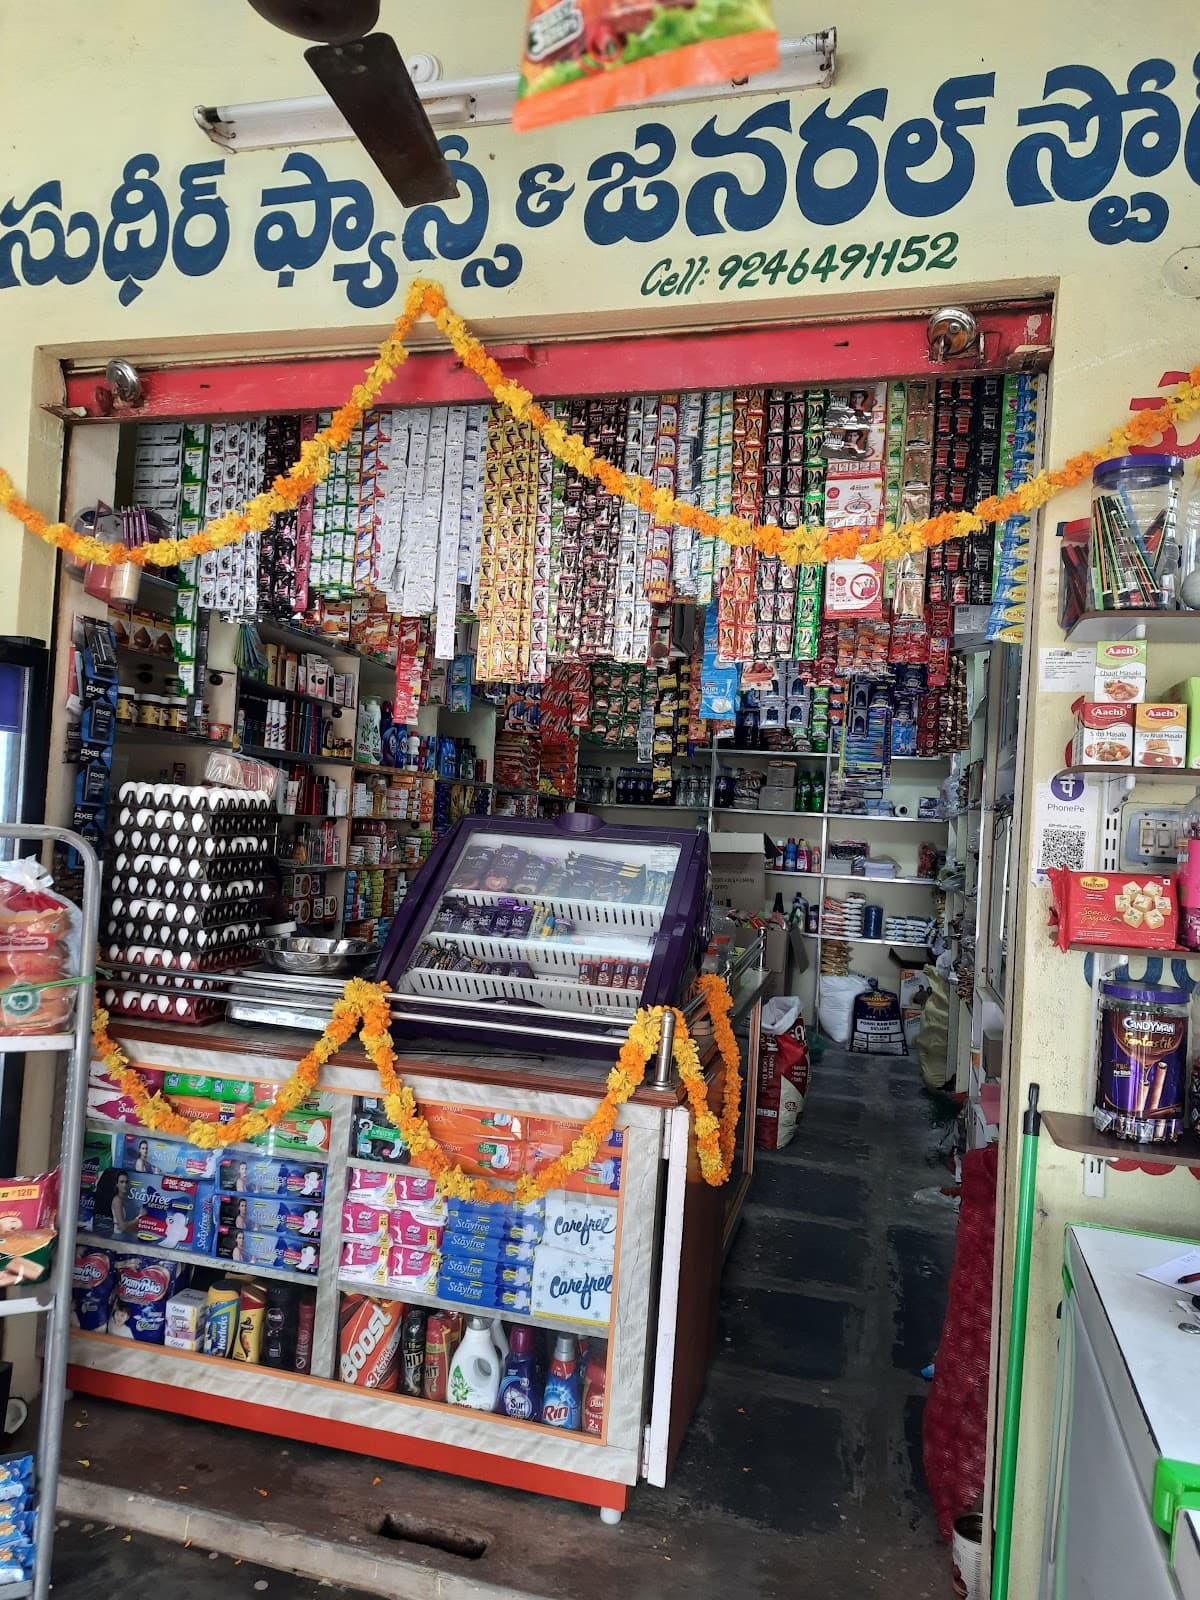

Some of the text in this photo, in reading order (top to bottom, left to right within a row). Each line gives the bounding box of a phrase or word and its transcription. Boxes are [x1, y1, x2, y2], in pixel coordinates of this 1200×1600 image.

[515, 163, 575, 228] &
[584, 72, 996, 245] జనరల్
[640, 231, 959, 295] Cell: 9246491152
[1106, 646, 1137, 655] Aachi
[86, 685, 105, 695] AXE
[95, 709, 111, 717] AXE
[1095, 708, 1125, 717] Aachi
[1147, 710, 1177, 718] Aachi
[81, 748, 100, 757] AXE
[74, 812, 94, 820] AXE
[1047, 804, 1085, 814] PhonePe
[1124, 1032, 1173, 1049] Fantastik
[128, 1186, 171, 1206] Stayfree
[151, 1225, 165, 1233] Large
[196, 1212, 209, 1250] Stayfree
[456, 1218, 490, 1233] Stayfree
[554, 1213, 617, 1246] Carefree
[451, 1235, 486, 1250] Stayfree
[448, 1260, 483, 1275] Stayfree
[447, 1281, 483, 1297] Stayfree
[550, 1272, 614, 1310] Carefree
[216, 1315, 228, 1350] Horlicks
[405, 1351, 424, 1368] HIT
[425, 1366, 439, 1377] HIT
[510, 1399, 526, 1409] Surf
[543, 1405, 569, 1420] Rin
